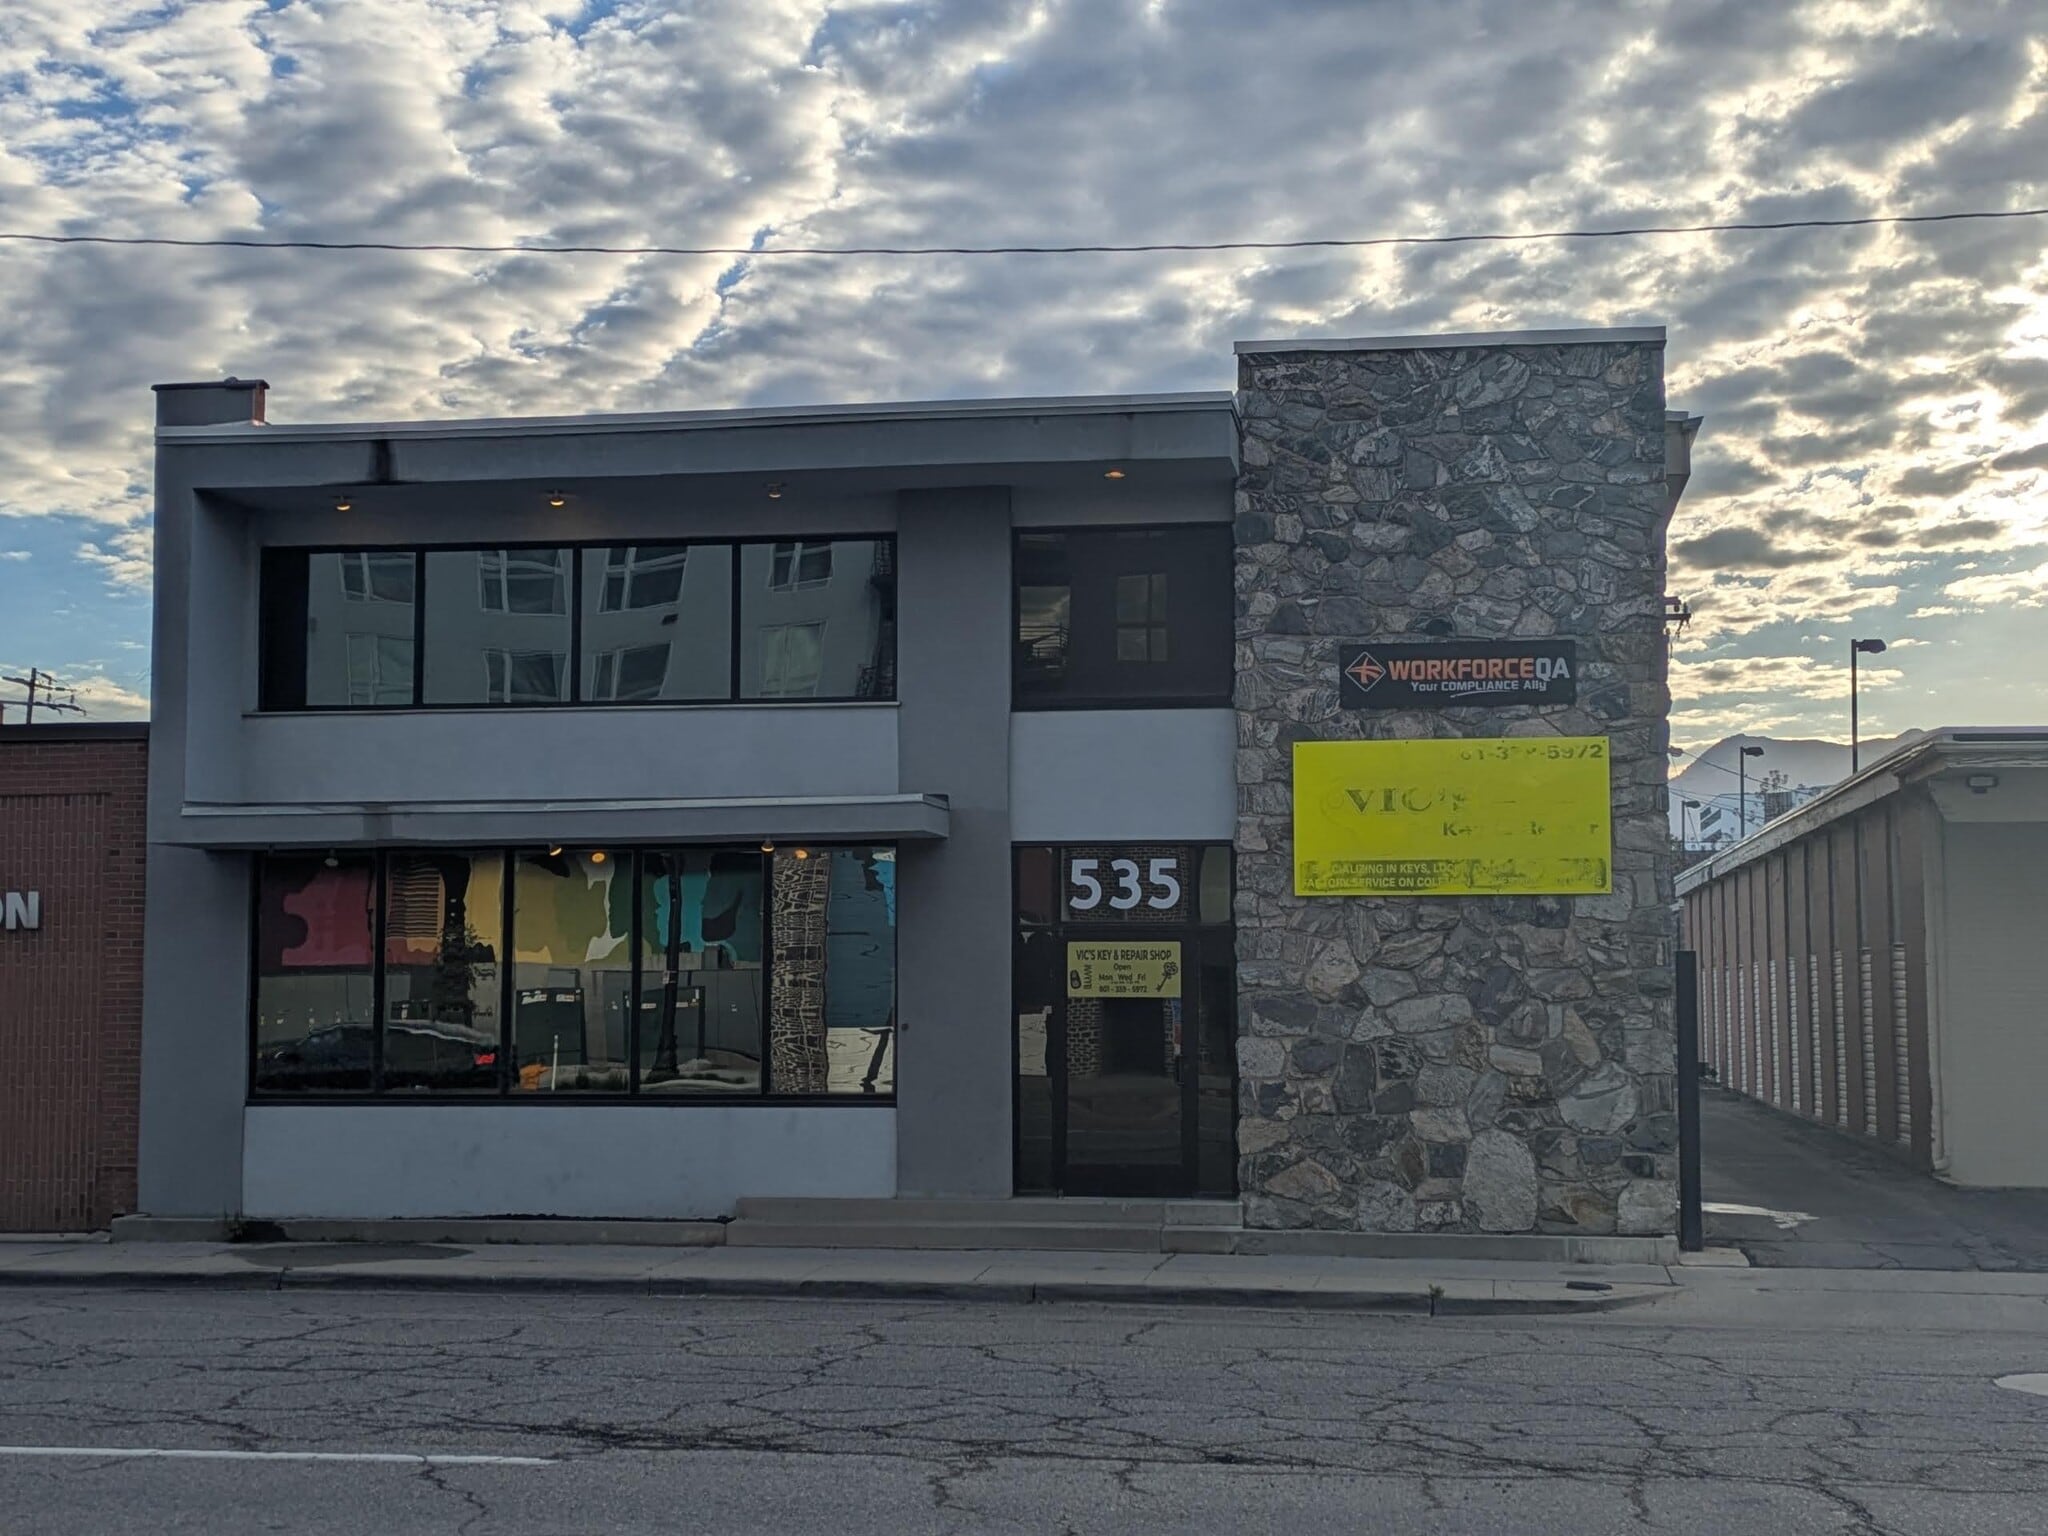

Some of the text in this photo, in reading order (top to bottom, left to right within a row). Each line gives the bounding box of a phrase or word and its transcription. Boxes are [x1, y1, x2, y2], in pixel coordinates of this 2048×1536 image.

[1388, 657, 1570, 681] WORKFORCEQA
[1411, 682, 1437, 692] Your
[1441, 680, 1519, 691] COMPLIANCE
[1386, 863, 1397, 873] IN
[1069, 858, 1181, 910] 535
[1398, 877, 1414, 887] ON
[0, 891, 39, 930] N
[1076, 949, 1172, 961] VIC'S KEY & REPAIR SHOP
[1113, 962, 1132, 971] Open
